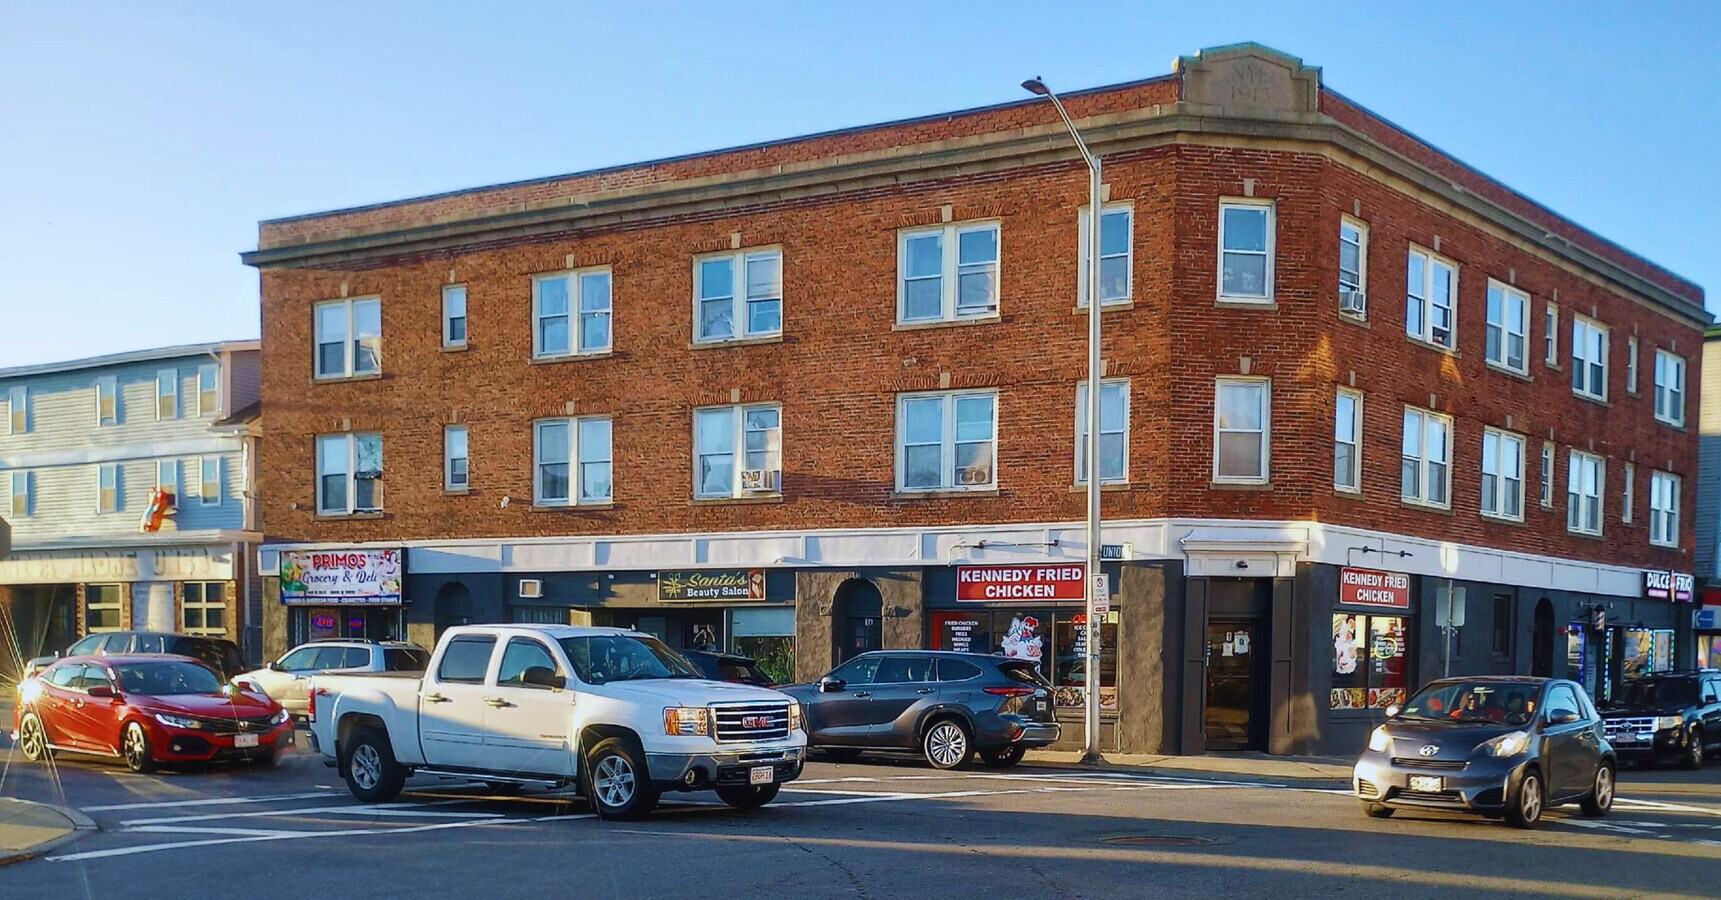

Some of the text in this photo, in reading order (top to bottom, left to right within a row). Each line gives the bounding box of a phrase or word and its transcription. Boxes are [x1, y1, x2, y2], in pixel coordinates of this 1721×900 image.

[1102, 546, 1124, 558] UNIO
[302, 569, 378, 585] Grocery & Deli
[685, 571, 748, 587] Santa's
[961, 568, 1083, 583] KENNEDY FRIED
[1343, 571, 1407, 589] KENNEDY FRIED
[1647, 572, 1670, 589] DULCE
[687, 586, 748, 598] Beauty Salon
[985, 585, 1056, 597] CHICKEN
[1356, 588, 1394, 603] CHICKEN
[742, 716, 774, 729] GMC
